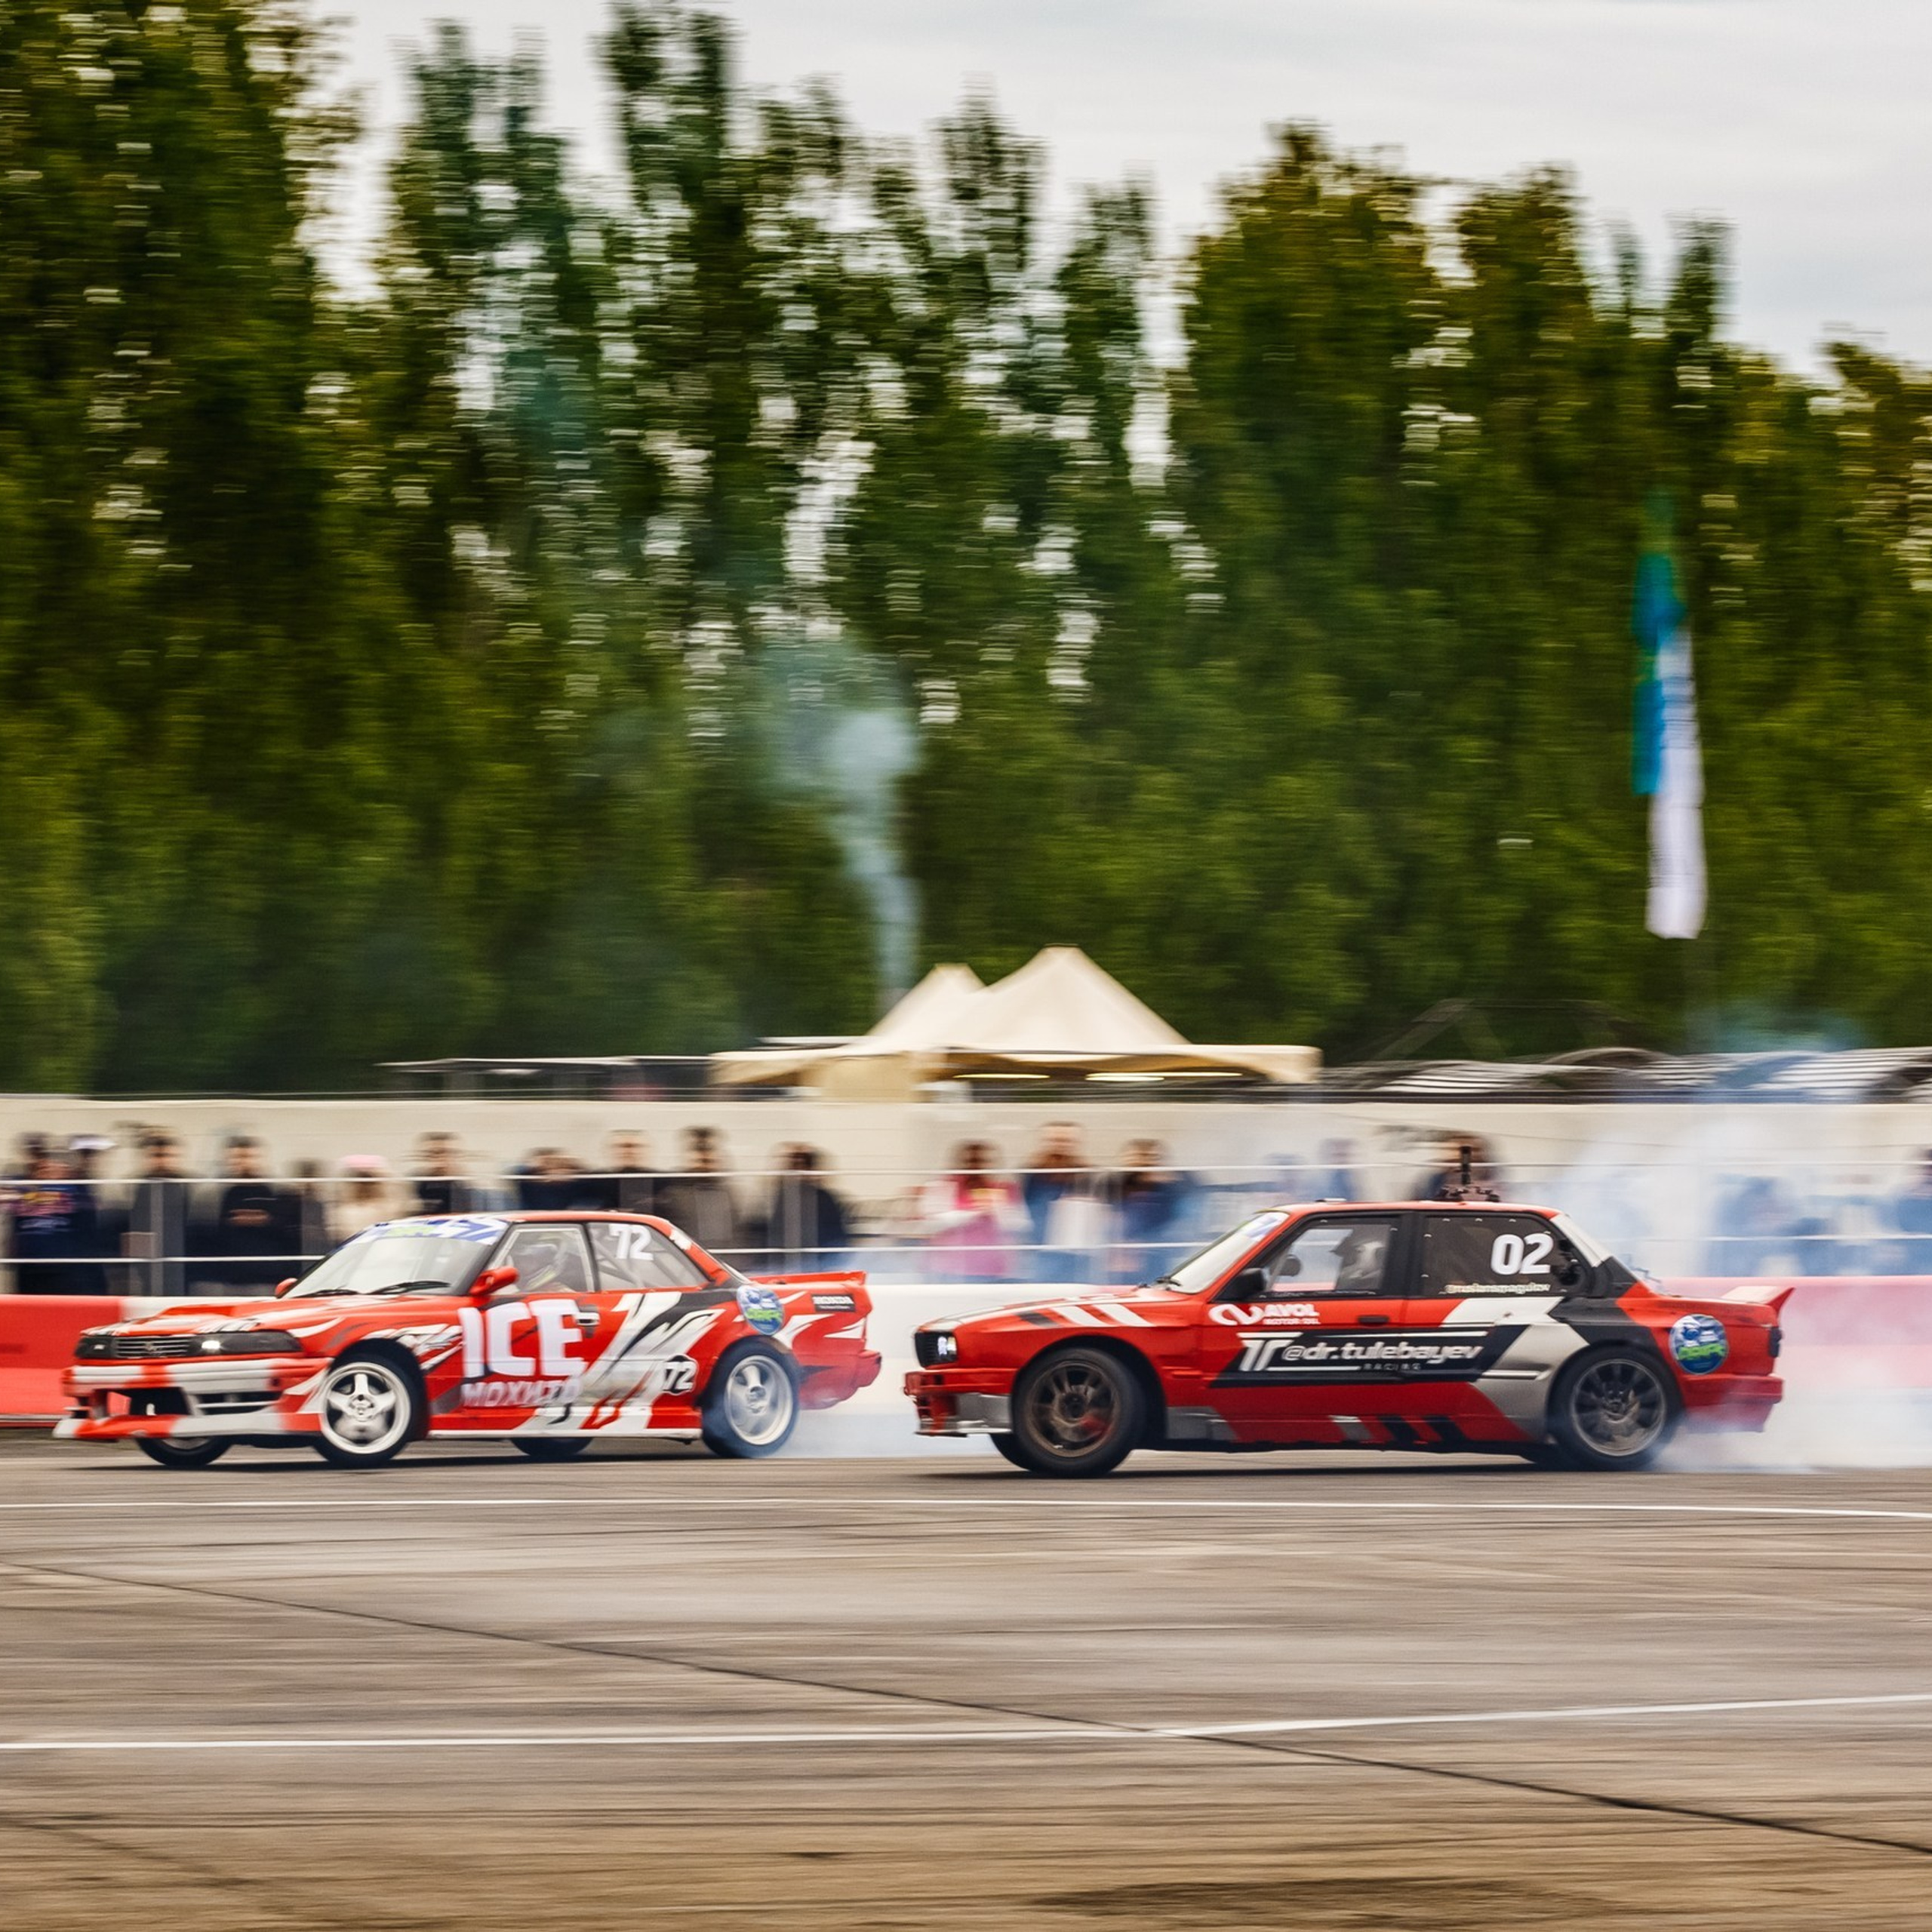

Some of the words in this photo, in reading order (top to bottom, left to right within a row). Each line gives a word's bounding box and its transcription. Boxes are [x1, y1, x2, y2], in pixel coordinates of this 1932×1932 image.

[609, 1223, 654, 1261] 72
[1491, 1233, 1554, 1275] 02
[457, 1299, 589, 1378] ICE
[664, 1361, 695, 1390] 72
